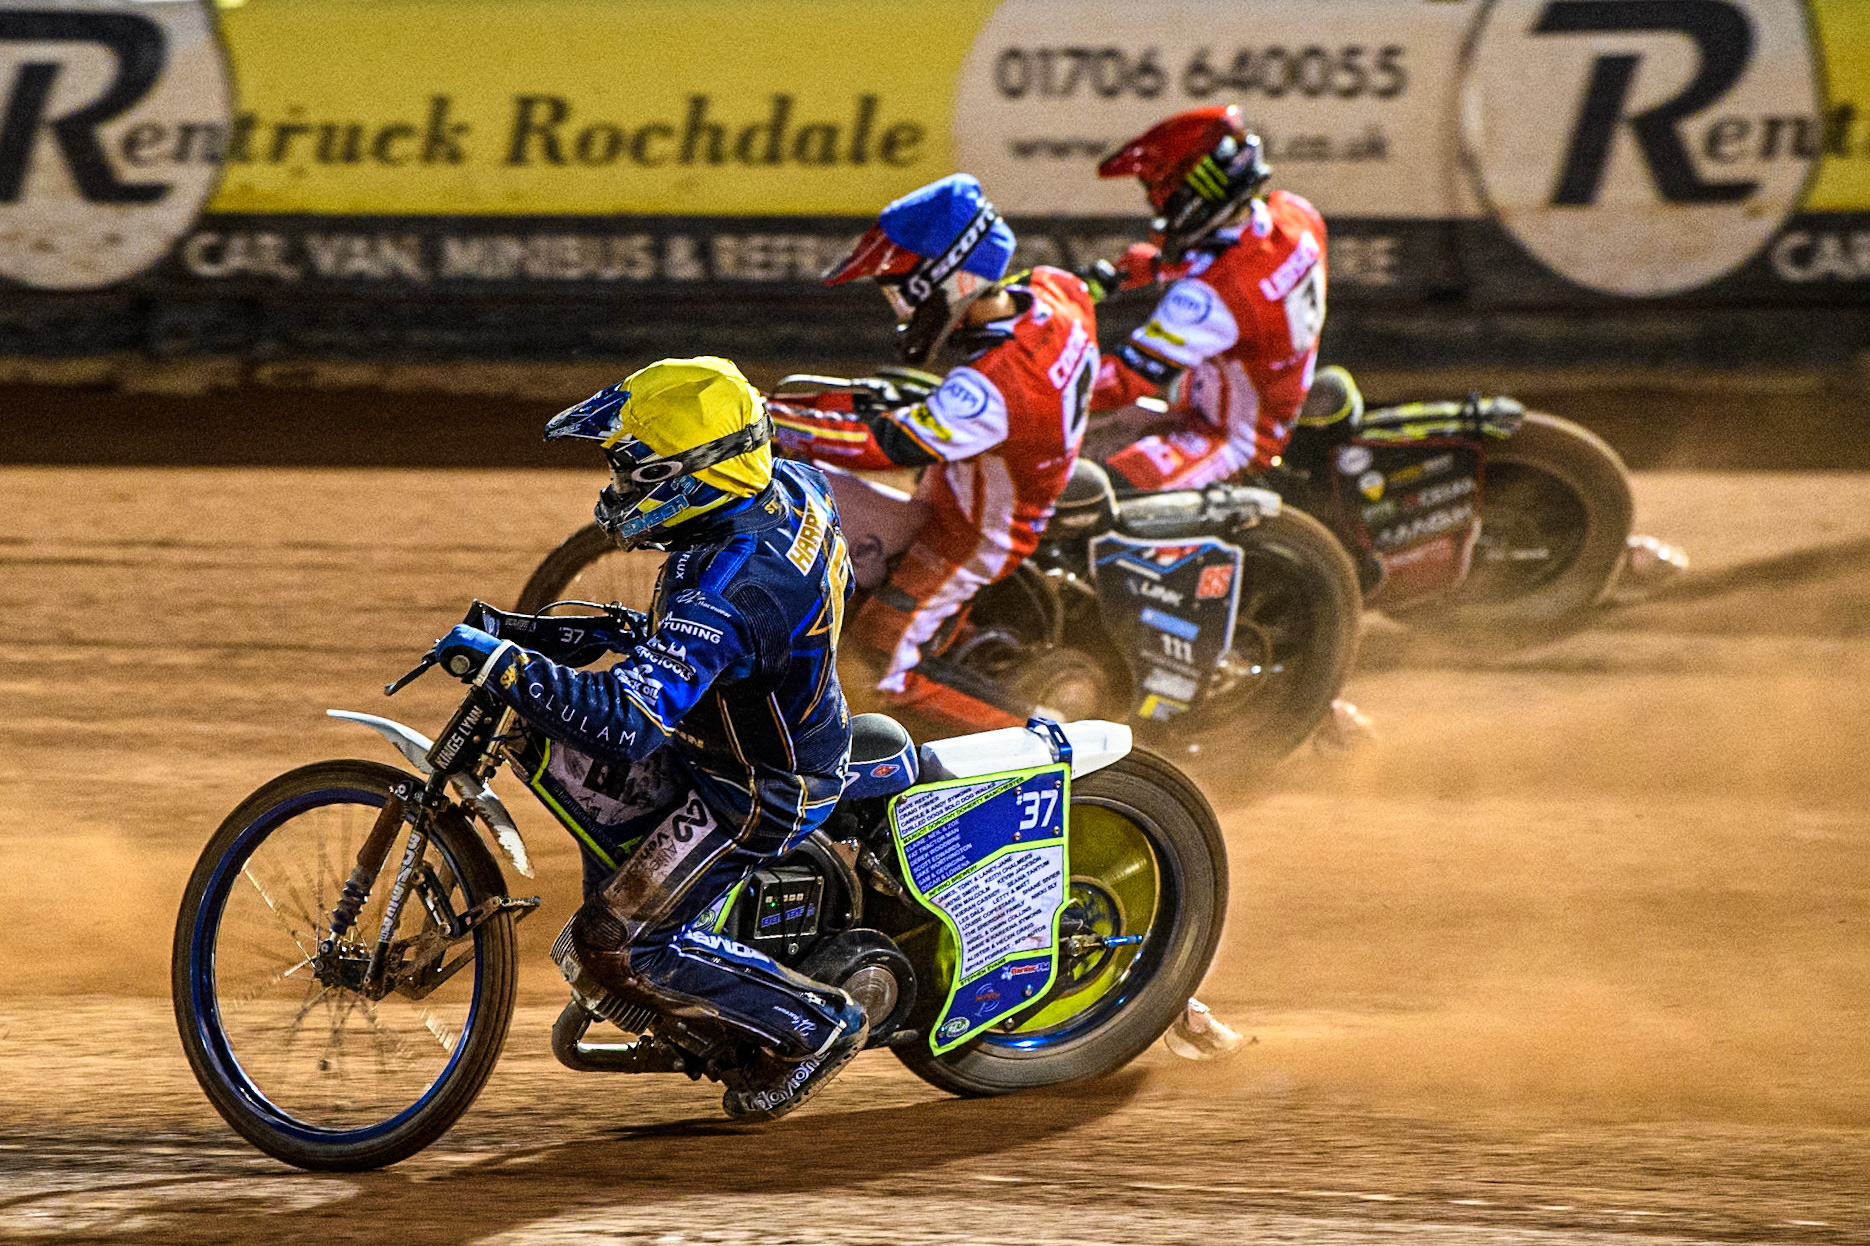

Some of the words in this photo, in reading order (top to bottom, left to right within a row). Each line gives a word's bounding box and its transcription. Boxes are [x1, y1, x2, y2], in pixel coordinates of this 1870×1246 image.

[996, 46, 1165, 99] 01706
[1184, 46, 1407, 99] 640055
[502, 93, 928, 168] Rochdale
[665, 236, 704, 279] &
[675, 552, 691, 581] FLUX
[663, 621, 721, 644] TUNING
[528, 682, 636, 746] GLULAM
[436, 734, 465, 770] KINGS
[458, 705, 484, 738] LYNN
[960, 793, 974, 802] DOG
[898, 807, 918, 820] CRAIG
[900, 811, 925, 827] CAROLE
[929, 799, 947, 811] ANDY
[920, 876, 941, 892] OSCAR
[957, 879, 973, 890] TONY
[961, 883, 980, 897] SMITH
[1021, 881, 1042, 895] SHANE
[991, 891, 1009, 904] LETTY
[954, 902, 976, 918] KIERAN
[964, 928, 976, 937] THE
[989, 919, 1007, 932] DAWN
